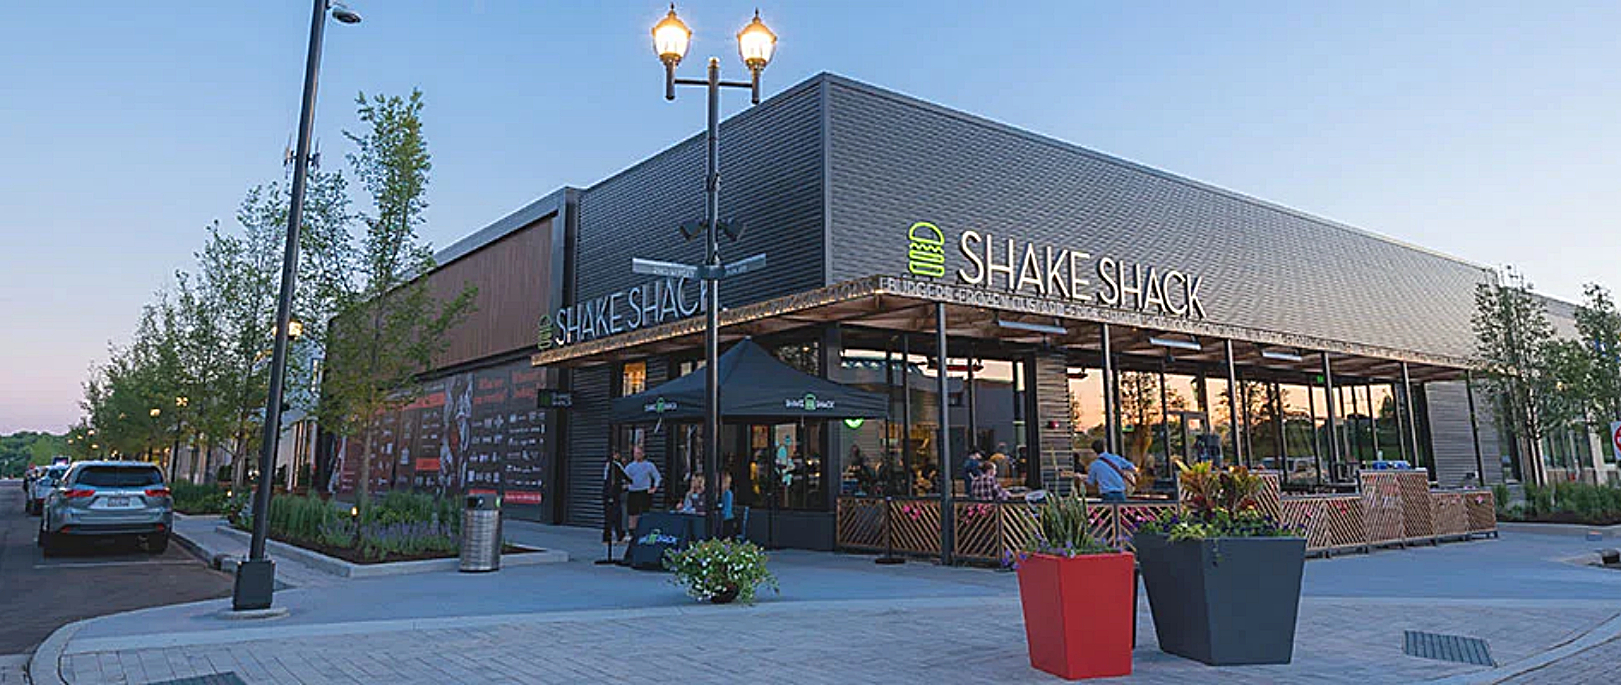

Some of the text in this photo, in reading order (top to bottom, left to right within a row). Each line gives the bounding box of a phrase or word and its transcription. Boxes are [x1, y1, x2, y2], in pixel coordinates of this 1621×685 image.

[958, 230, 1207, 319] SHAKE SHACK
[556, 292, 624, 346] SHAKE
